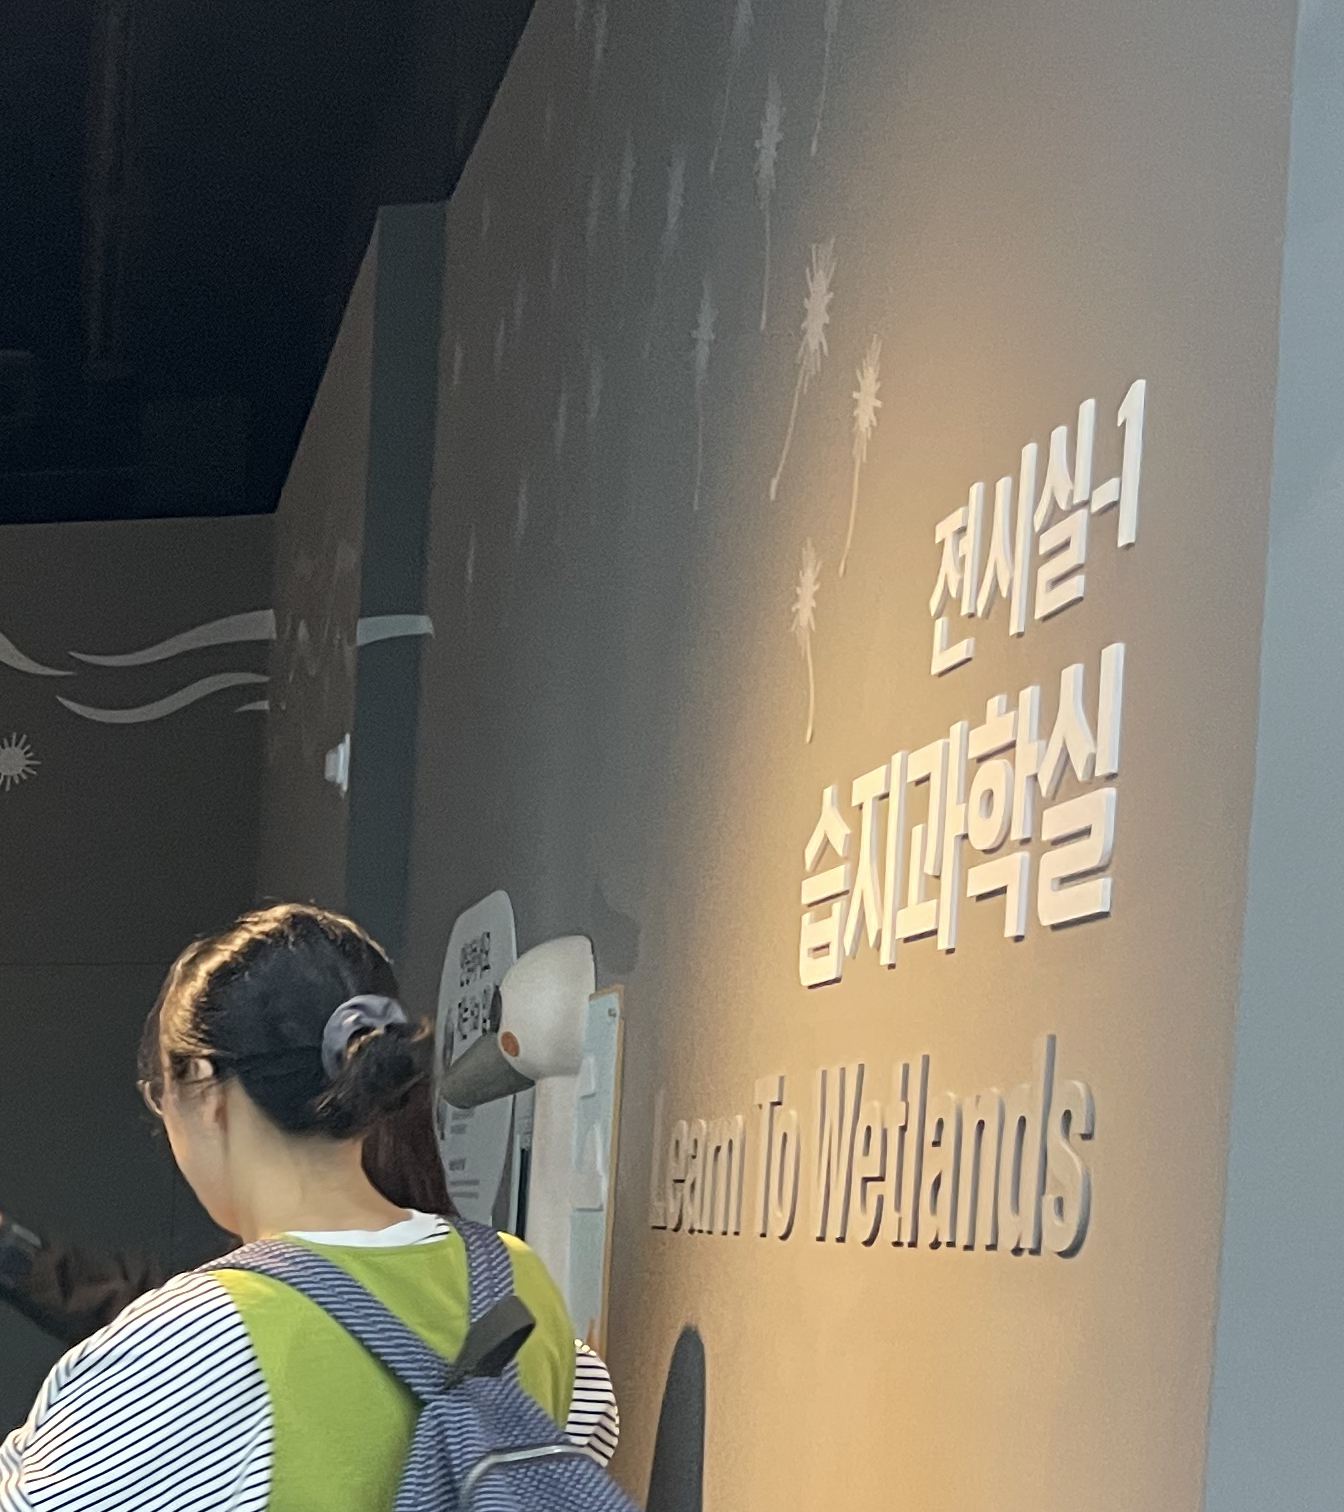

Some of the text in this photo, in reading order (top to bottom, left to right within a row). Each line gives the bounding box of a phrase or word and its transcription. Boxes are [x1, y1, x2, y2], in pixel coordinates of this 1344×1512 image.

[929, 378, 1146, 677] 전시실-1
[799, 642, 1125, 988] 습지과학실
[648, 1034, 1096, 1259] Learn To Wetlands
